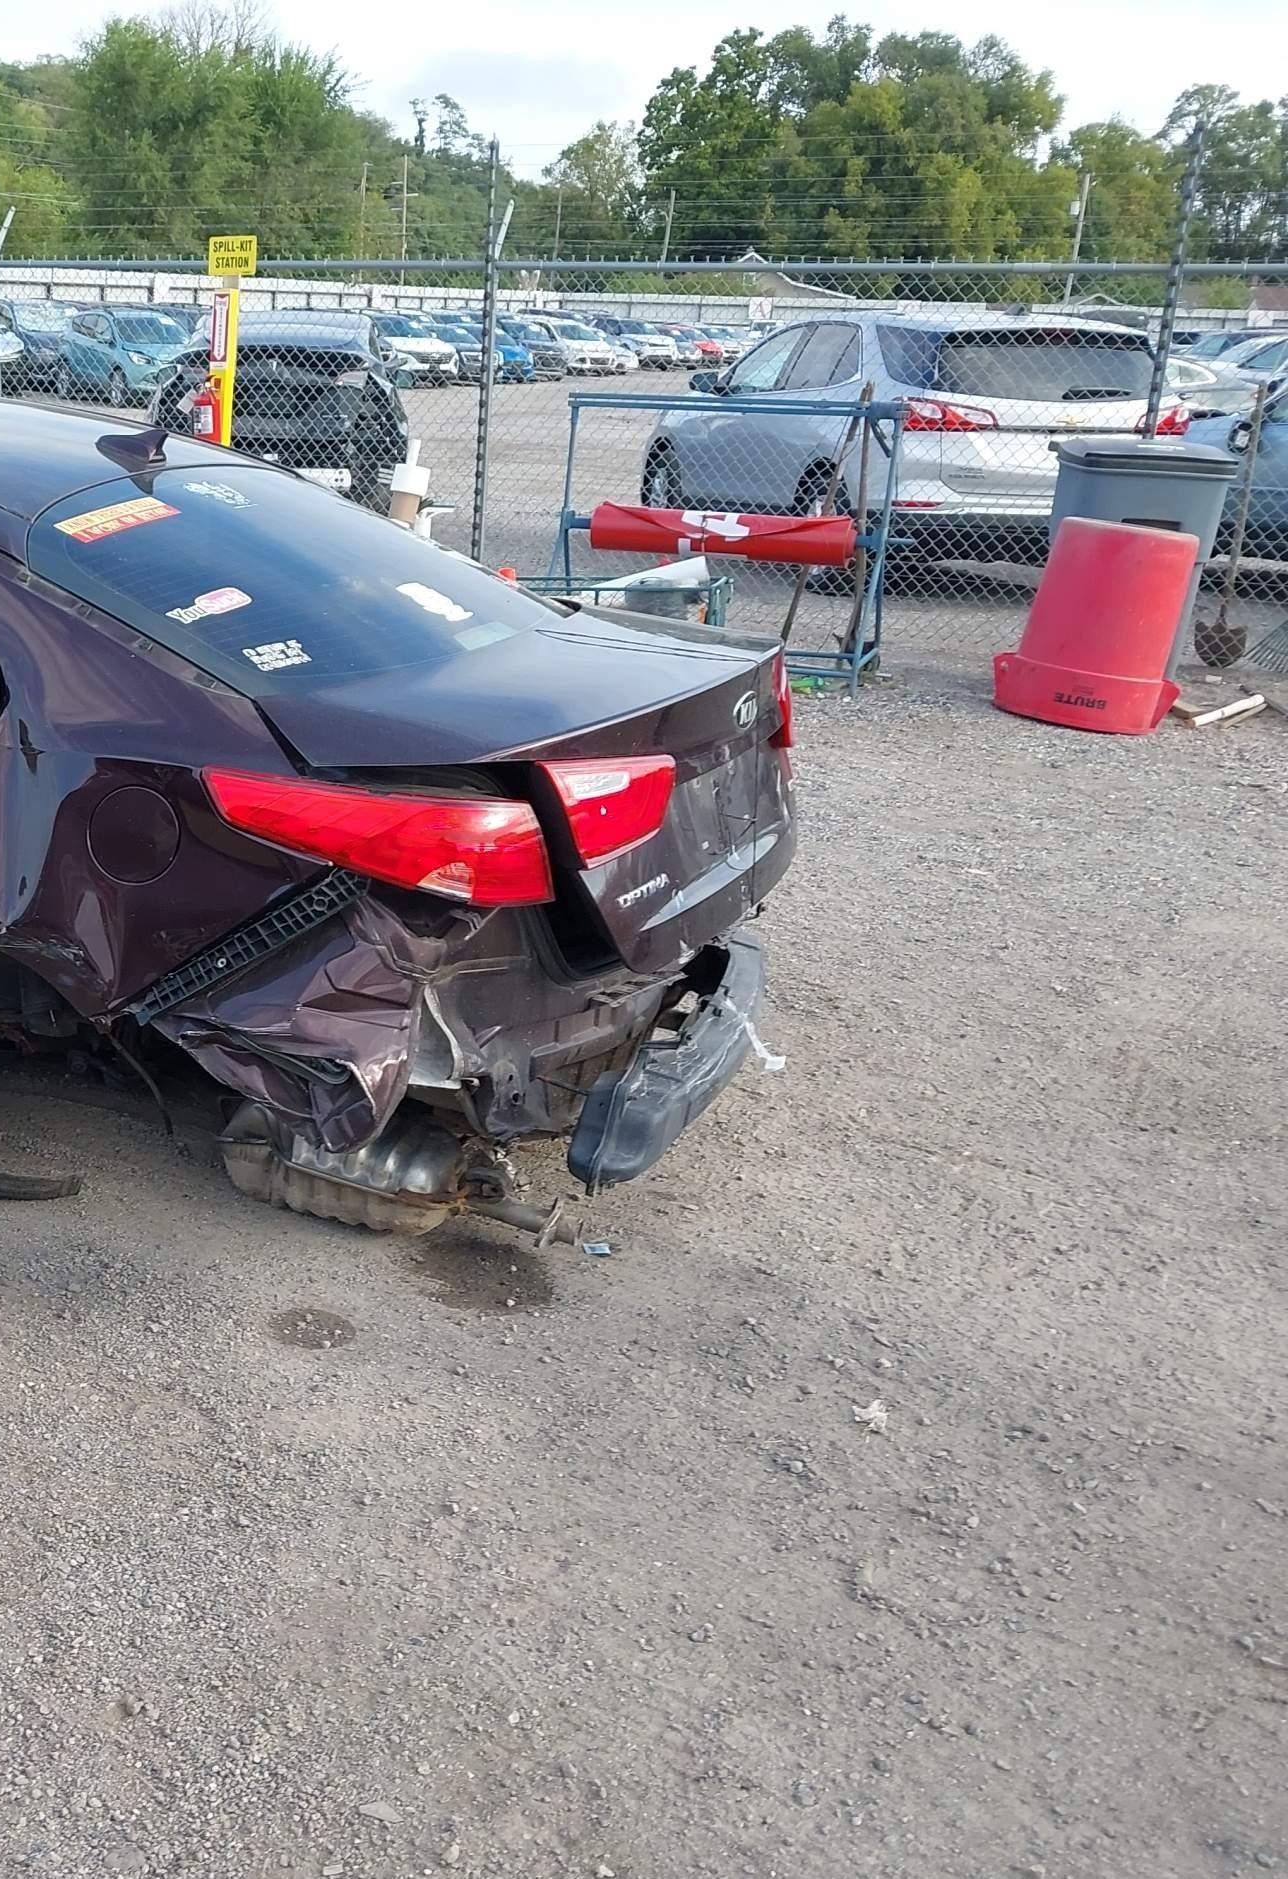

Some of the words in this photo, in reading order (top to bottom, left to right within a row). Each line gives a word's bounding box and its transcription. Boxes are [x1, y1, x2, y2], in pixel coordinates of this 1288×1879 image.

[213, 240, 253, 253] SPILL-KIT
[215, 256, 250, 269] STATION
[1054, 692, 1107, 709] BRUTE
